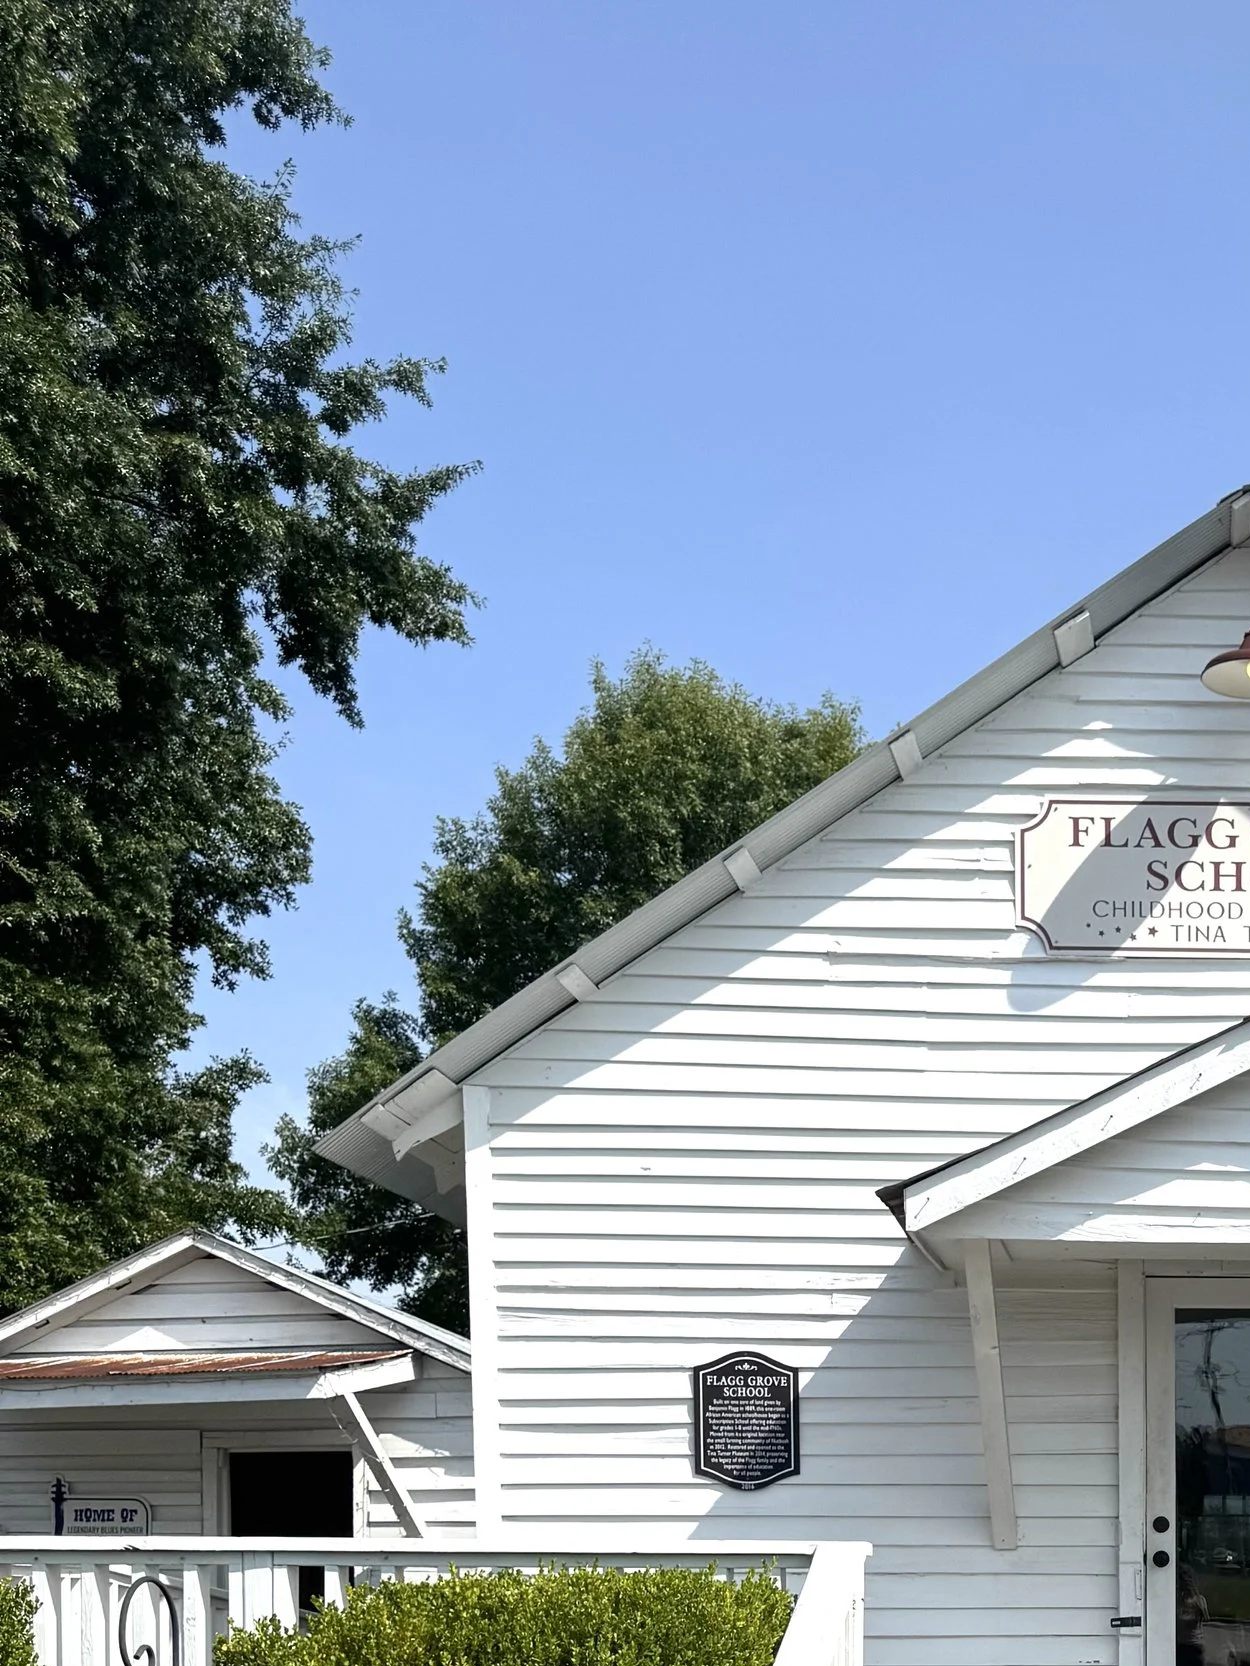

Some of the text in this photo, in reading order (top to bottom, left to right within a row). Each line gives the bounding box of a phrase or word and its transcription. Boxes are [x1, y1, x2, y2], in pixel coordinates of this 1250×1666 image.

[1067, 815, 1240, 849] FLAGG
[1092, 899, 1244, 920] CHILDHOOD
[1170, 924, 1227, 943] TINA
[706, 1375, 788, 1387] FLAGG GROVE
[723, 1386, 772, 1398] SCHOOL
[73, 1508, 138, 1523] HOME OF
[66, 1526, 144, 1534] LEGENDARY BLUES PIONEER
